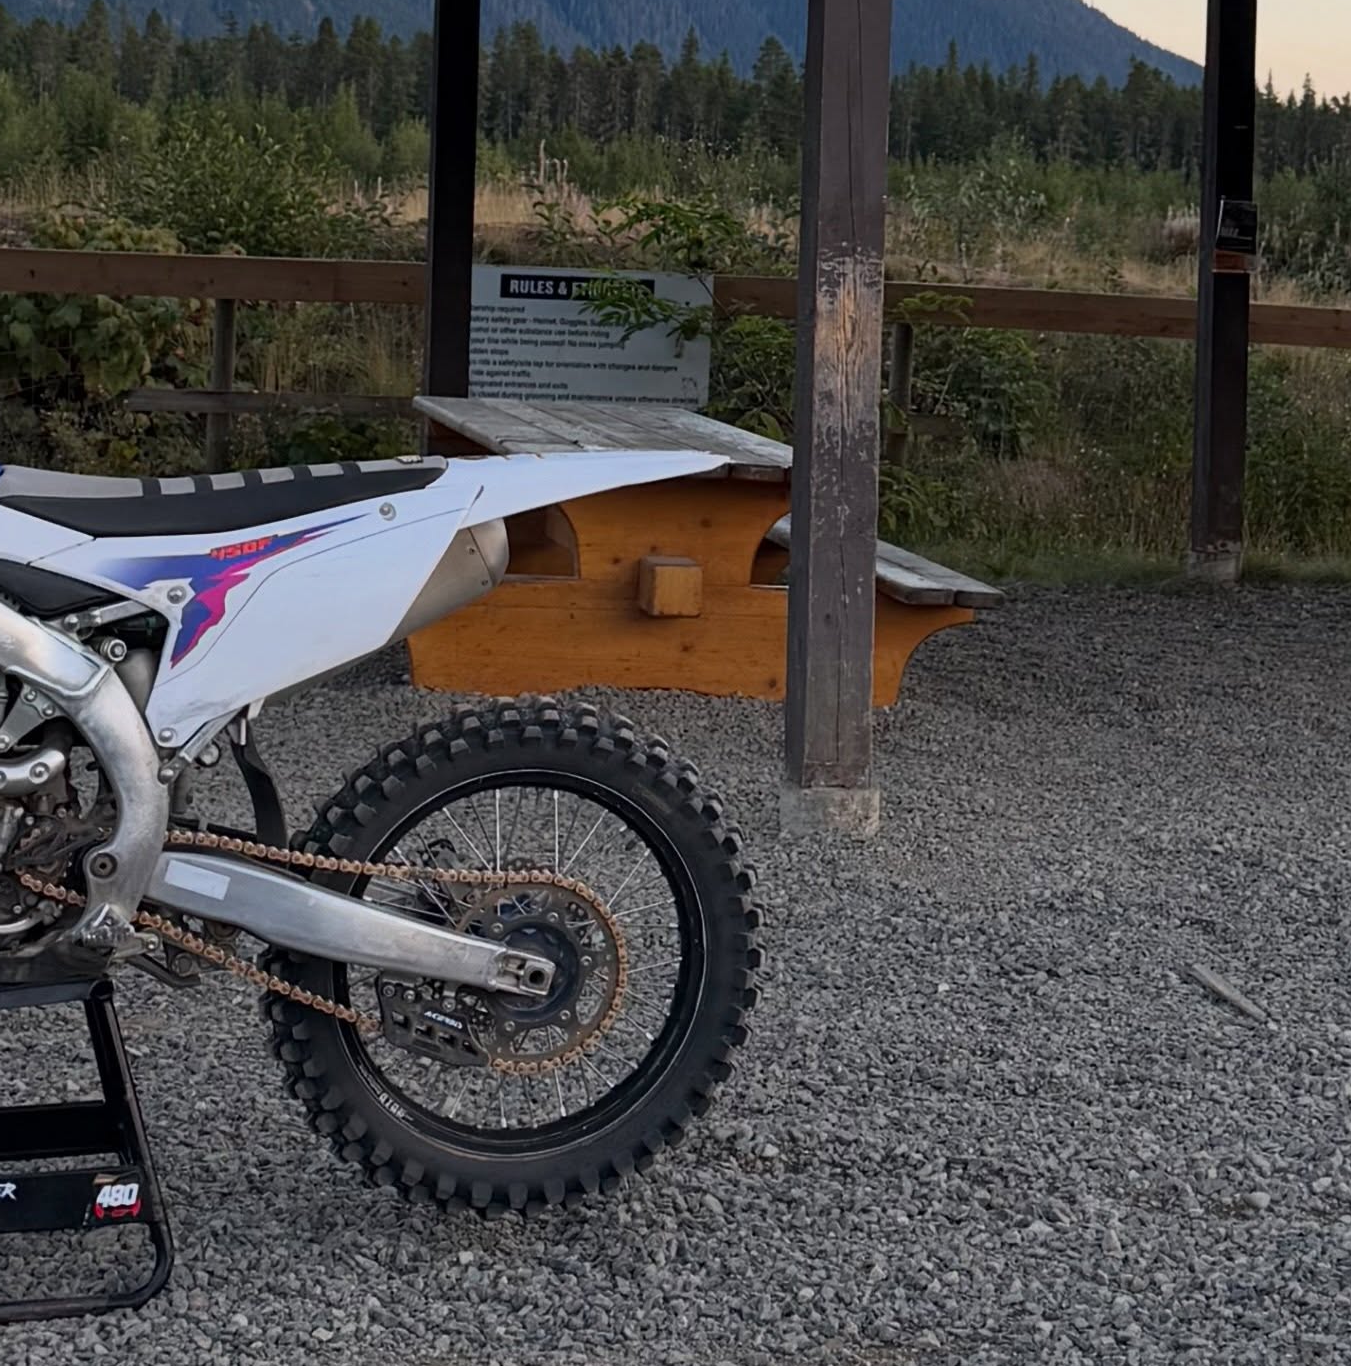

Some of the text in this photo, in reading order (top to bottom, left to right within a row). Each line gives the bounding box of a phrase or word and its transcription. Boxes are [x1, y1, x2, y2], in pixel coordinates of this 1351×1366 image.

[509, 279, 554, 295] RULES
[557, 282, 568, 296] &
[96, 1183, 140, 1209] 480
